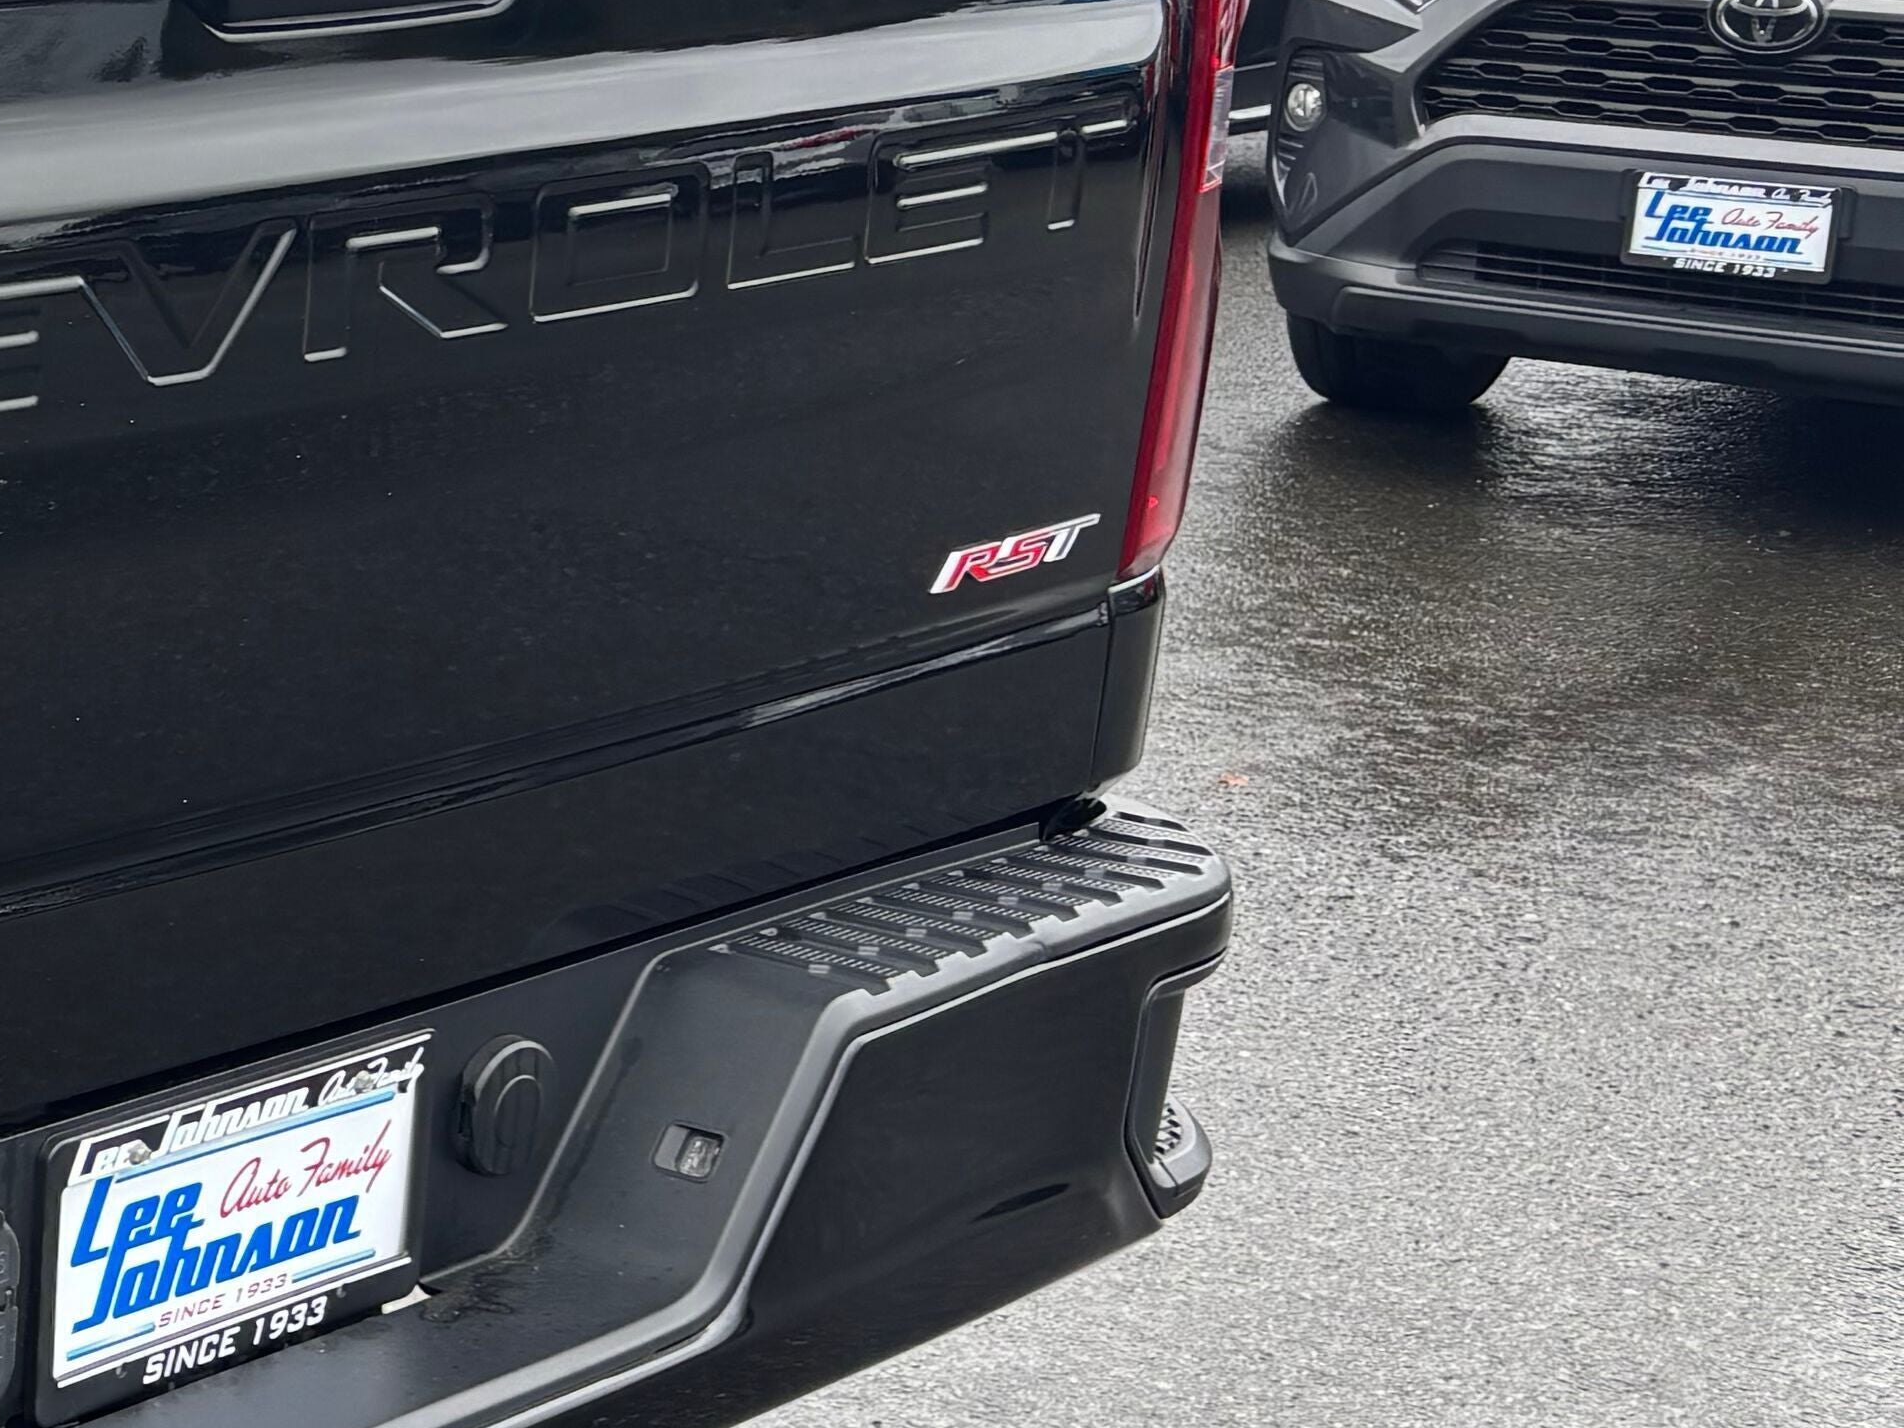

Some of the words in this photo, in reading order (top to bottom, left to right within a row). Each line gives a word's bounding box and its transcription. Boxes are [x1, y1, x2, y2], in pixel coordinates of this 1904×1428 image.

[1644, 191, 1713, 223] Lee
[1721, 208, 1762, 227] Auto
[1765, 211, 1819, 238] Family
[1645, 219, 1803, 255] Johnson
[1673, 258, 1727, 273] SINCE
[1733, 263, 1776, 278] 1933
[929, 513, 1101, 594] RST
[149, 1084, 310, 1155] Johnson
[318, 1070, 372, 1106] Au
[70, 1176, 205, 1268] Lee
[219, 1156, 292, 1219] Auto
[297, 1120, 392, 1197] Family
[71, 1194, 362, 1334] Johnson
[158, 1294, 224, 1329] SINCE
[235, 1273, 288, 1307] 1933
[142, 1328, 237, 1385] SINCE
[252, 1296, 328, 1345] 1933
